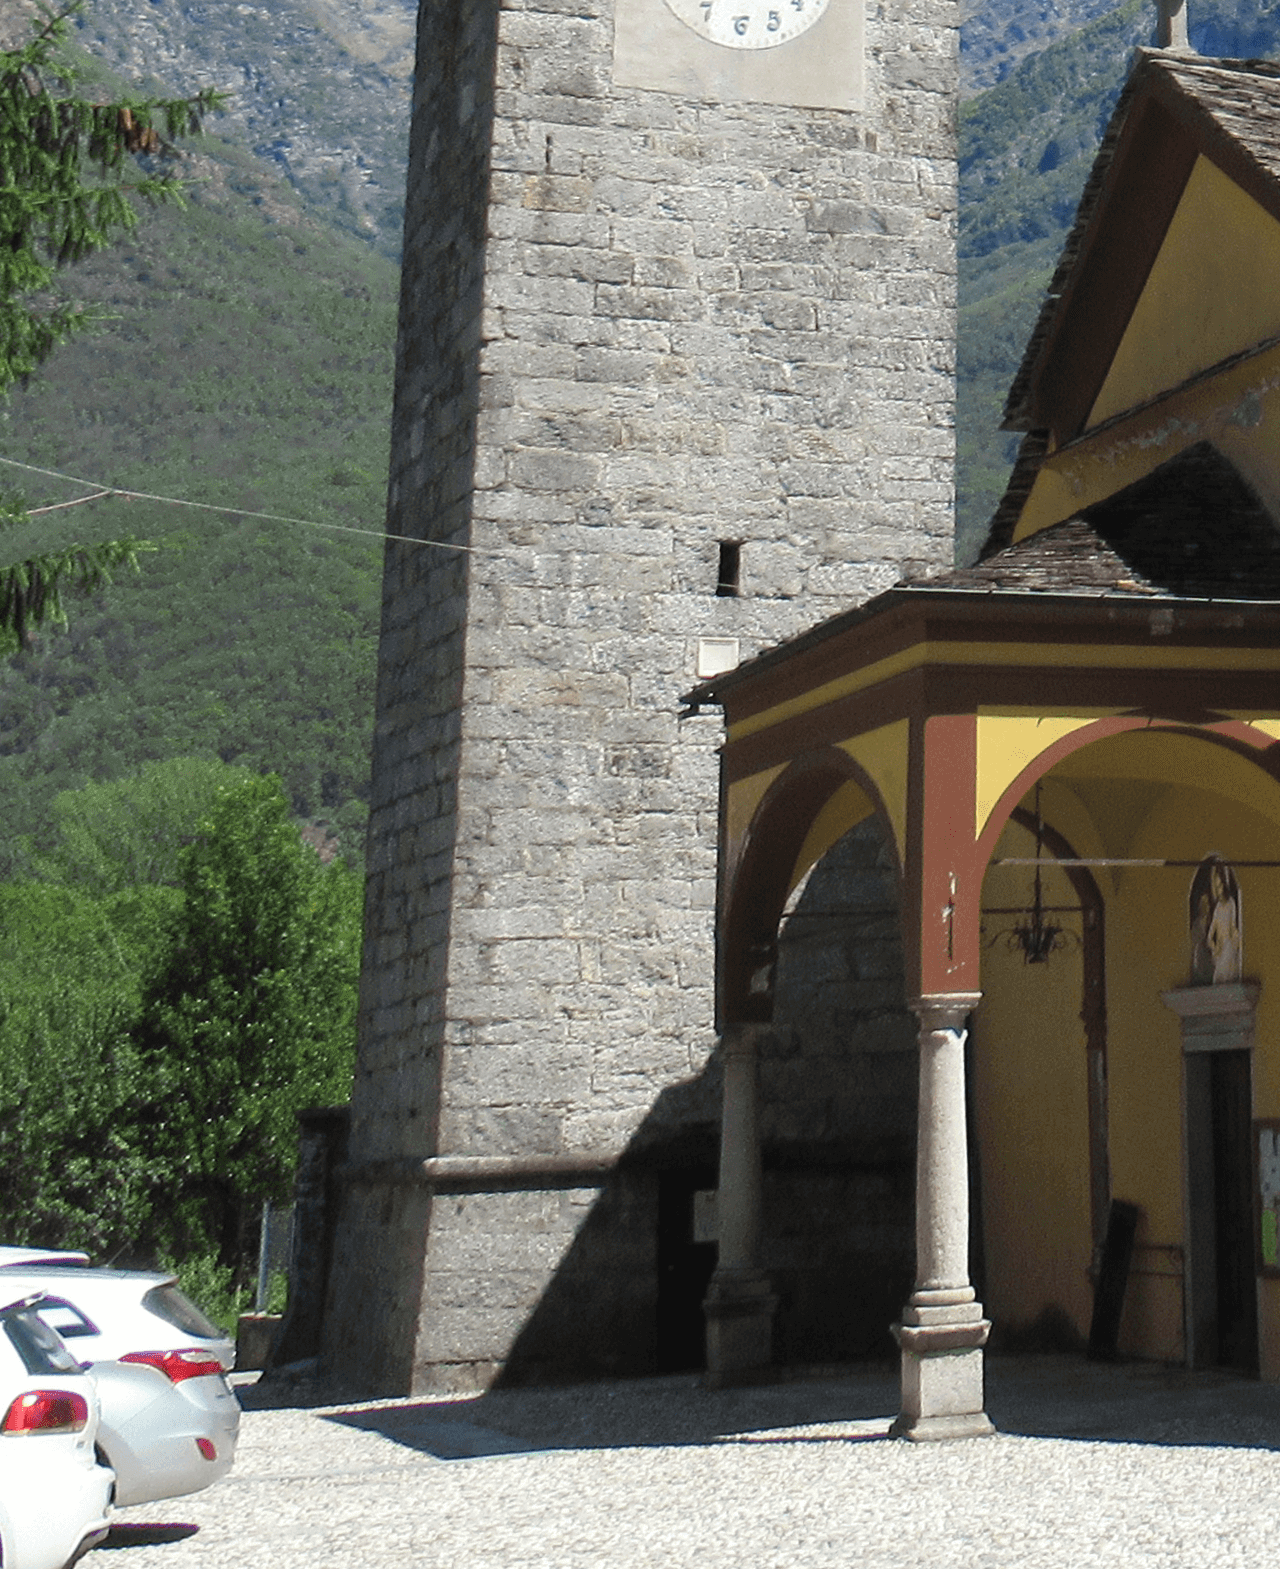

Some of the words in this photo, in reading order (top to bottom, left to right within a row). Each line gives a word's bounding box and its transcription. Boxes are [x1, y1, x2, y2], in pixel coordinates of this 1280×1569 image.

[699, 1, 713, 22] 7
[766, 10, 782, 32] 5
[733, 15, 750, 36] 6
